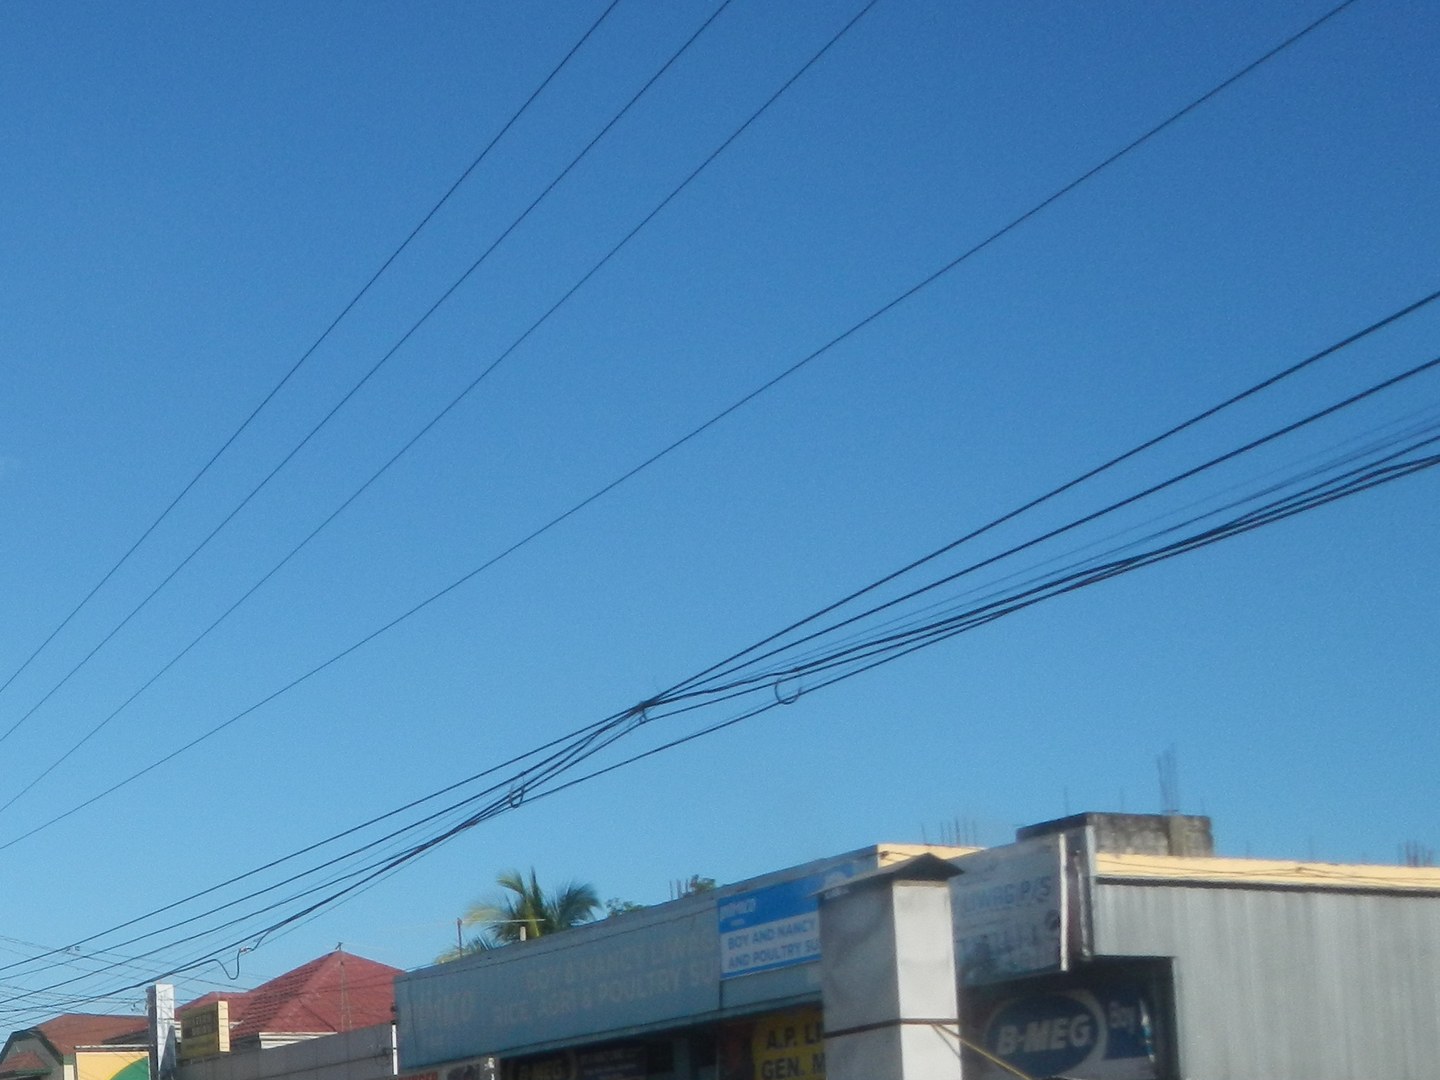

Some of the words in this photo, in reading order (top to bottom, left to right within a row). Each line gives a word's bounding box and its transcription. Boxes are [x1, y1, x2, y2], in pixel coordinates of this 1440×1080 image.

[728, 934, 749, 950] BOY
[752, 928, 776, 945] AND
[777, 919, 815, 940] NANCY
[728, 952, 751, 970] AND
[753, 943, 802, 965] POULTRY
[996, 1014, 1091, 1056] B-MEG
